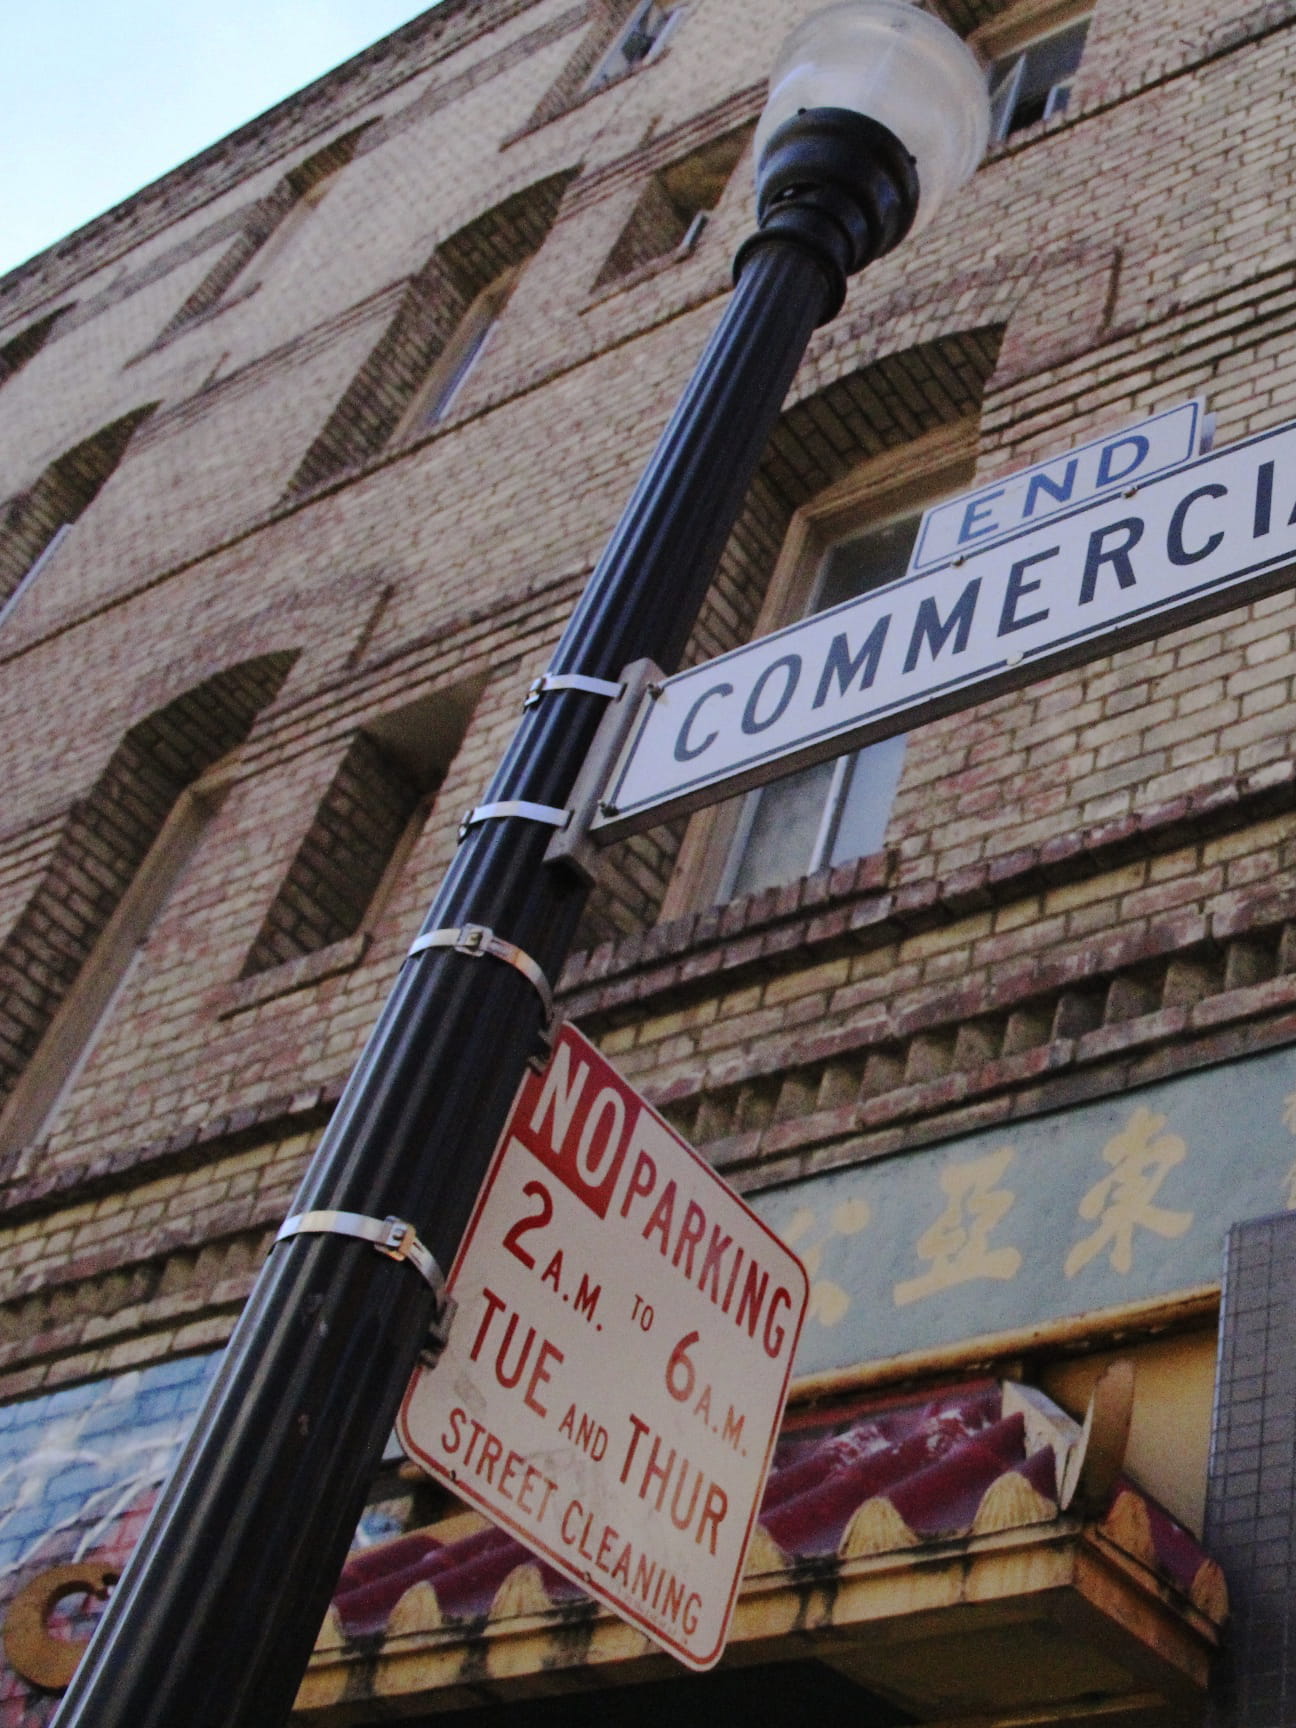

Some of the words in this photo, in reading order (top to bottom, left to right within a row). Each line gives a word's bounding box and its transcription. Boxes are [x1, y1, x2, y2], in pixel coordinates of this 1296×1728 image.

[957, 434, 1151, 546] END
[528, 1044, 626, 1189] NO
[620, 1149, 794, 1359] PARKING
[630, 1293, 656, 1333] TO
[441, 1406, 559, 1524] STREET
[560, 1503, 703, 1637] CLEANING
[468, 1286, 565, 1418] TUE
[558, 1403, 609, 1463] AND
[618, 1413, 730, 1558] THUR
